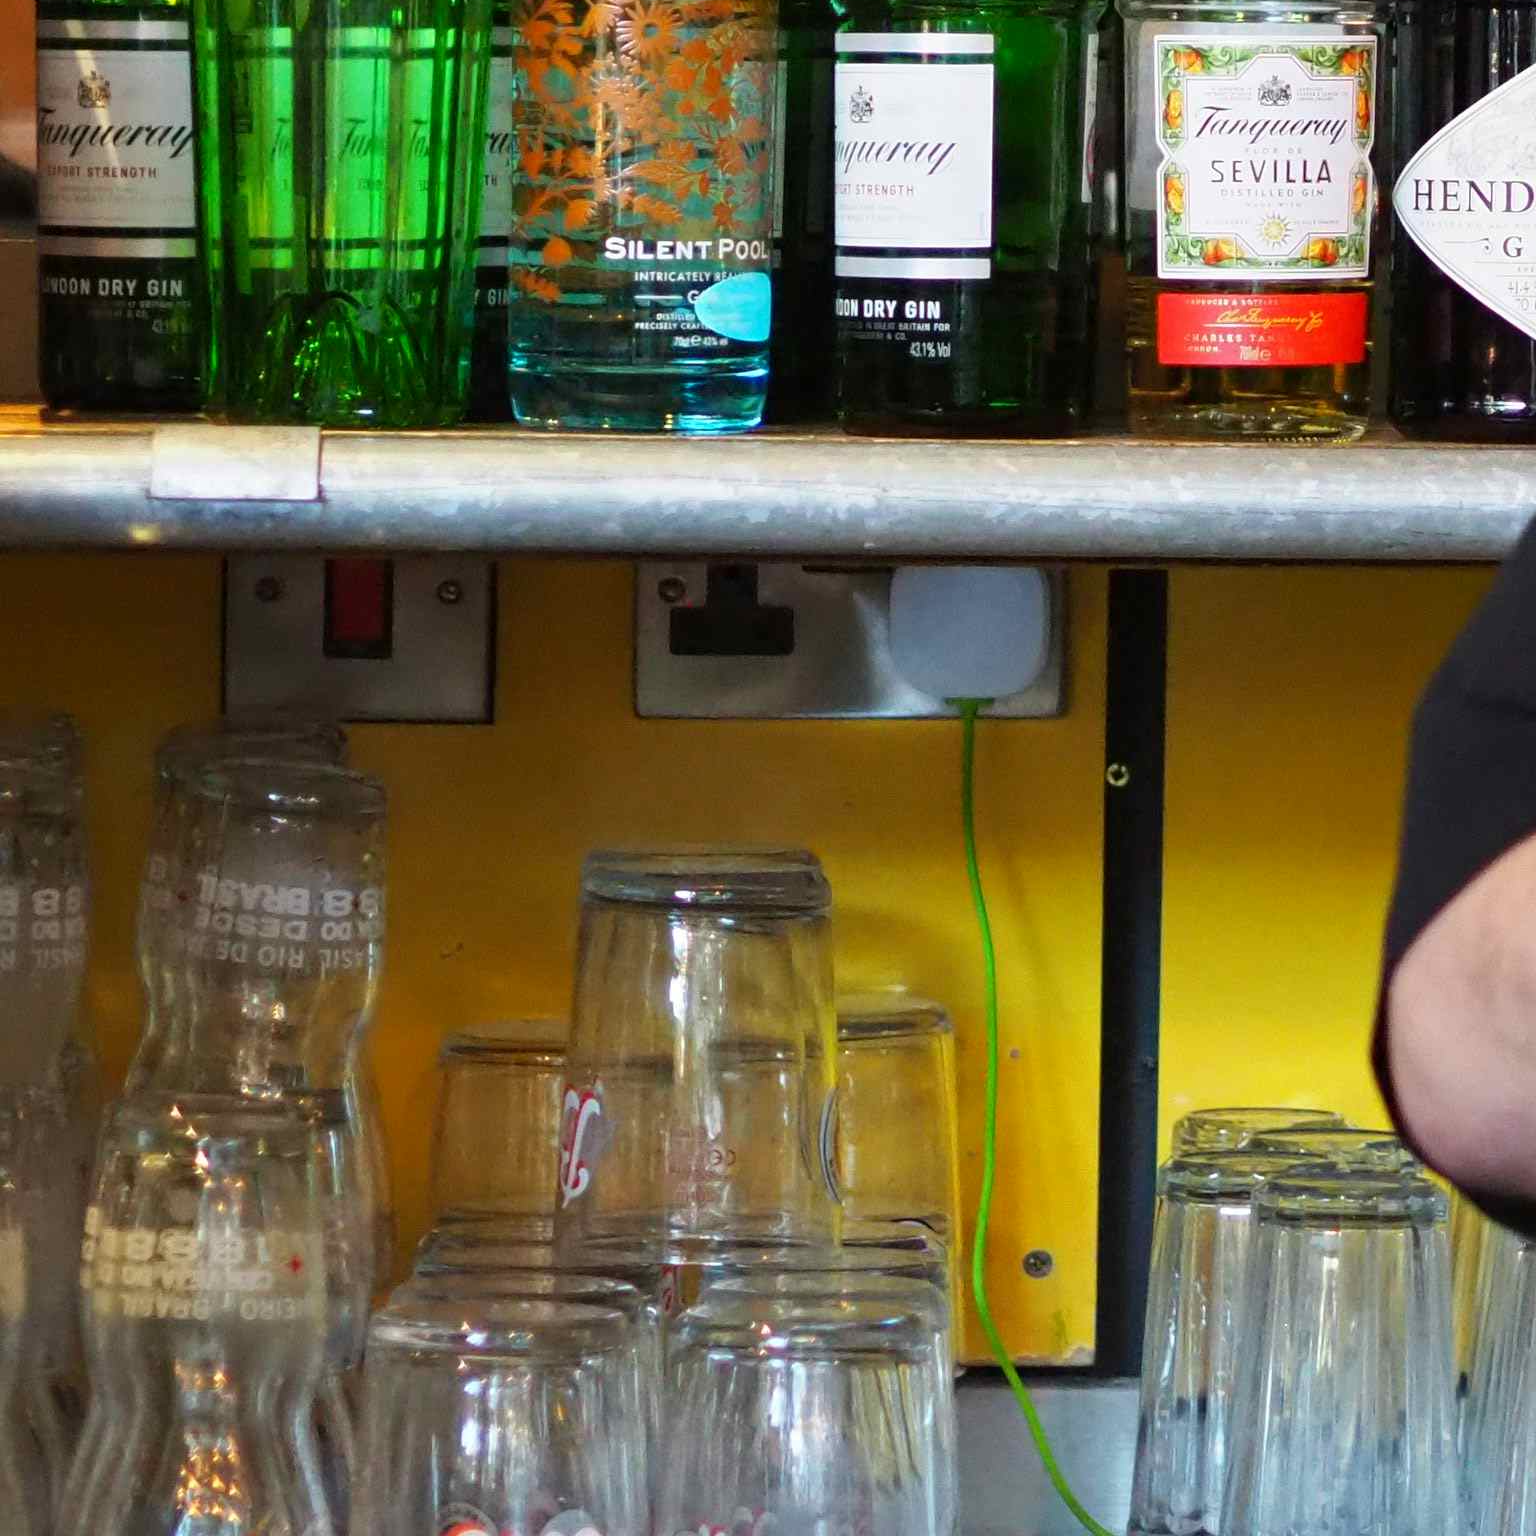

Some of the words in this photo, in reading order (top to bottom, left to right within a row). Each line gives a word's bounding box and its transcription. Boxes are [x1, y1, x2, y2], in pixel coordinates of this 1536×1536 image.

[36, 106, 194, 159] Tanqueray
[1195, 105, 1349, 146] Tanqueray
[86, 166, 158, 180] STRENGTH
[1210, 159, 1333, 184] SEVILLA
[855, 184, 914, 196] STRENGTH
[1220, 188, 1295, 198] DISTILLED
[1301, 188, 1325, 198] GIN
[604, 236, 713, 261] SILENT
[718, 238, 770, 261] POOL
[634, 271, 711, 283] INTRICATELY
[97, 279, 138, 298] DRY
[147, 279, 184, 298] GIN
[863, 298, 897, 319] DRY
[904, 300, 942, 319] GIN
[634, 322, 678, 331] PRECISELY
[933, 322, 951, 332] FOR
[1183, 333, 1243, 343] CHARLES
[909, 341, 935, 358] 43.1%
[936, 342, 951, 358] Vol
